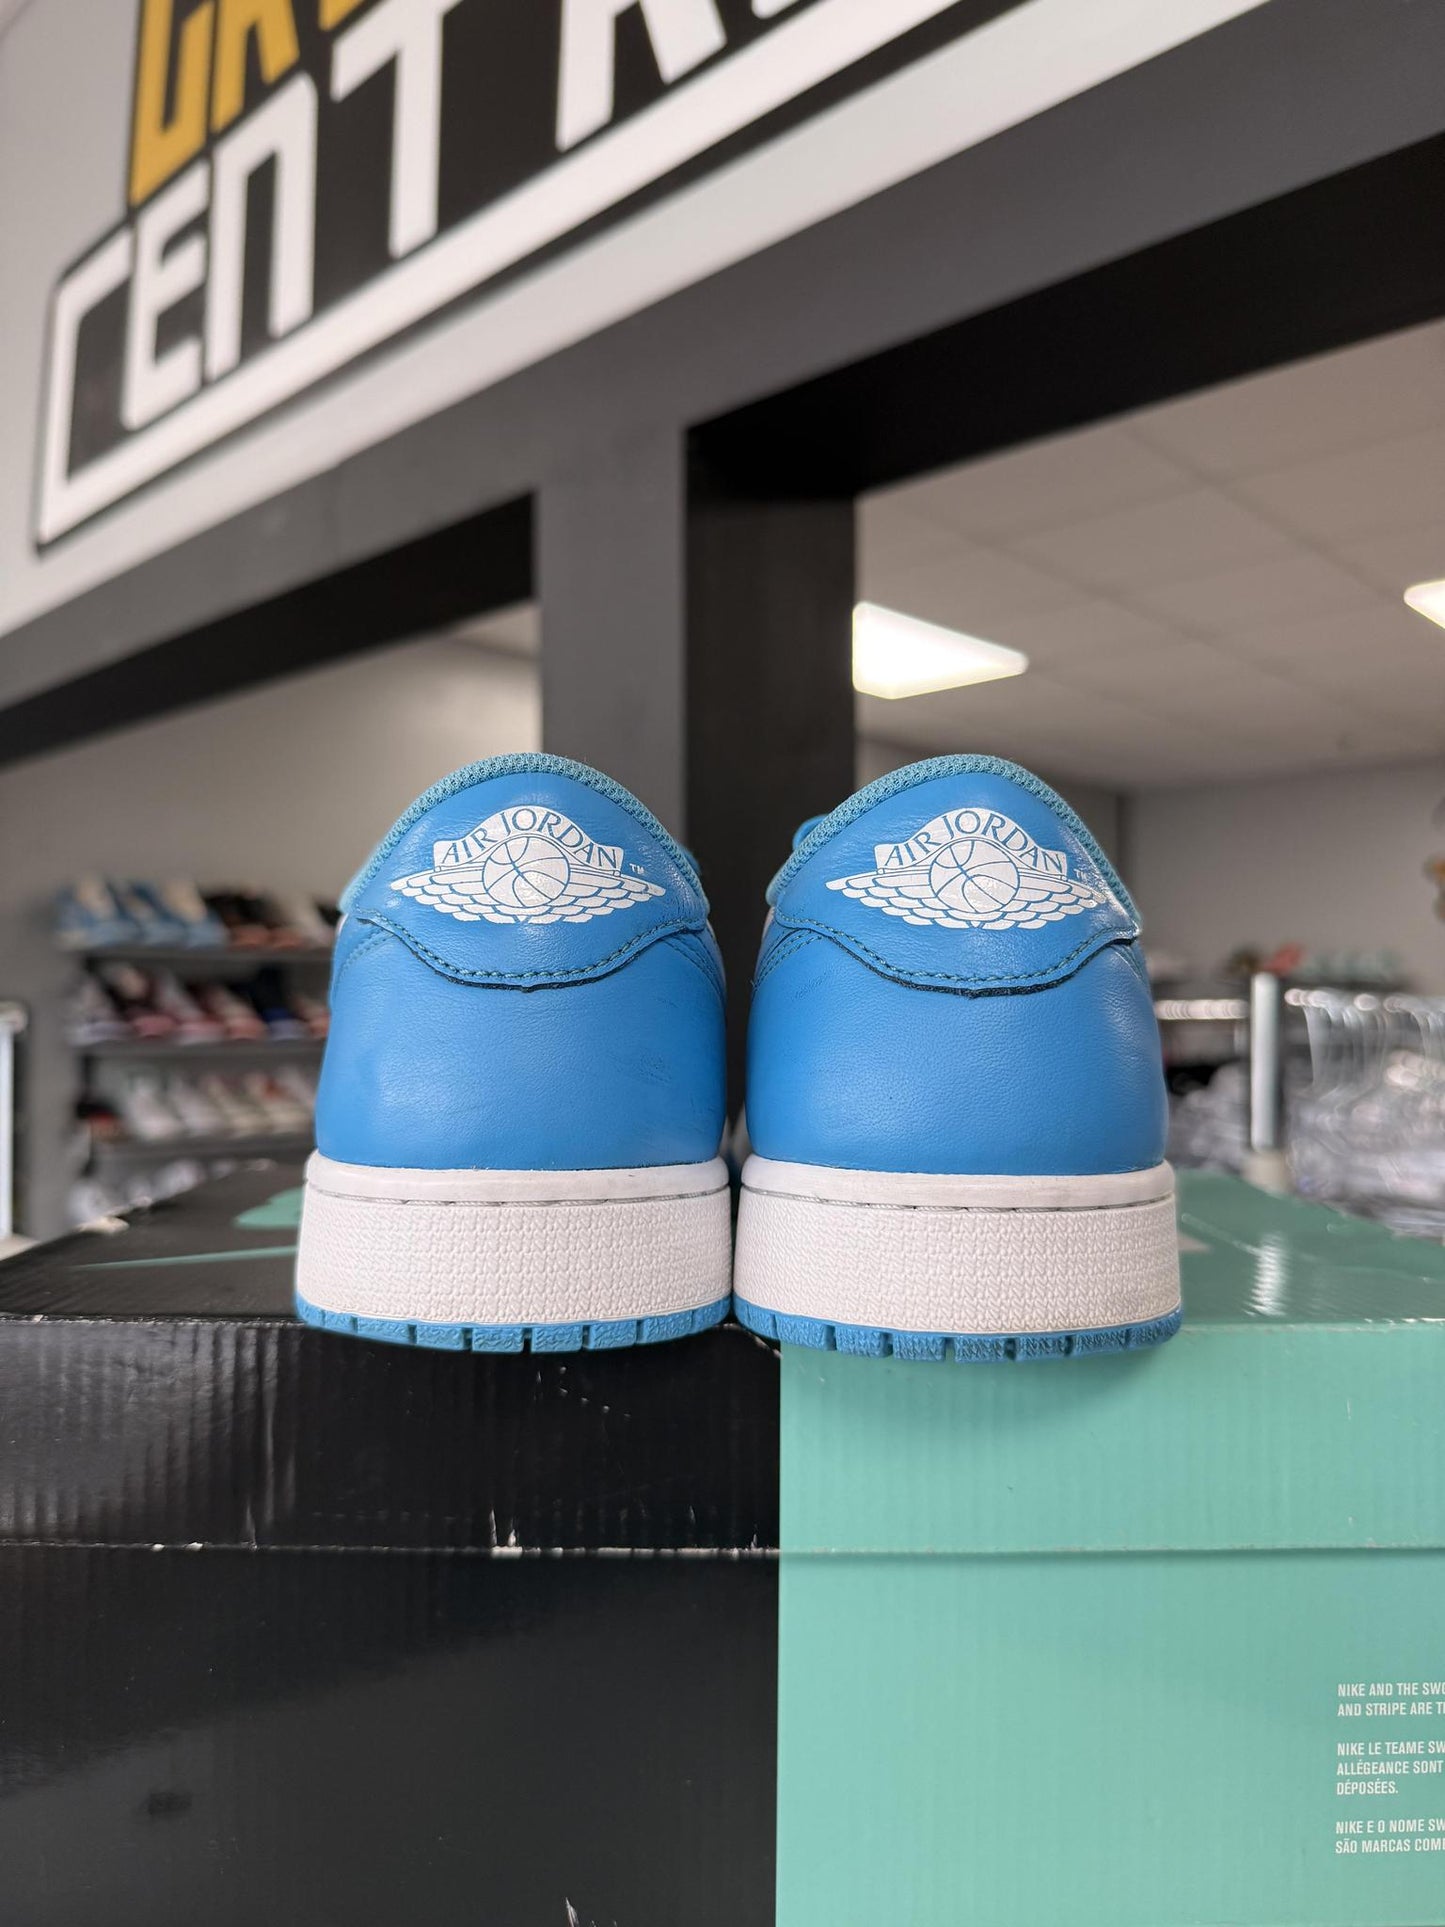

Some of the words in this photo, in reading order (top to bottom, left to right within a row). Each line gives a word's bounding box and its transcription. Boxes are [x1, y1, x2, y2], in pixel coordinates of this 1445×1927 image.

[441, 827, 499, 865] AIR
[500, 807, 618, 869] JORDAN
[884, 830, 941, 867] AIR
[942, 809, 1064, 874] JORDAN
[1337, 1683, 1366, 1697] NIKE
[1369, 1683, 1393, 1696] AND
[1396, 1682, 1419, 1696] THE
[1337, 1703, 1362, 1717] AND
[1365, 1702, 1407, 1716] STRIPE
[1410, 1702, 1433, 1715] ARE
[1337, 1742, 1365, 1756] NIKE
[1368, 1742, 1382, 1755] LE
[1336, 1759, 1409, 1776] ALLÉGEANCE
[1412, 1760, 1444, 1774] SONT
[1336, 1778, 1399, 1795] DÉPOSÉES.
[1336, 1821, 1363, 1834] NIKE
[1366, 1820, 1374, 1834] E
[1377, 1820, 1386, 1834] O
[1389, 1819, 1425, 1833] NOME
[1335, 1838, 1358, 1854] SÃO
[1361, 1839, 1411, 1853] MARCAS
